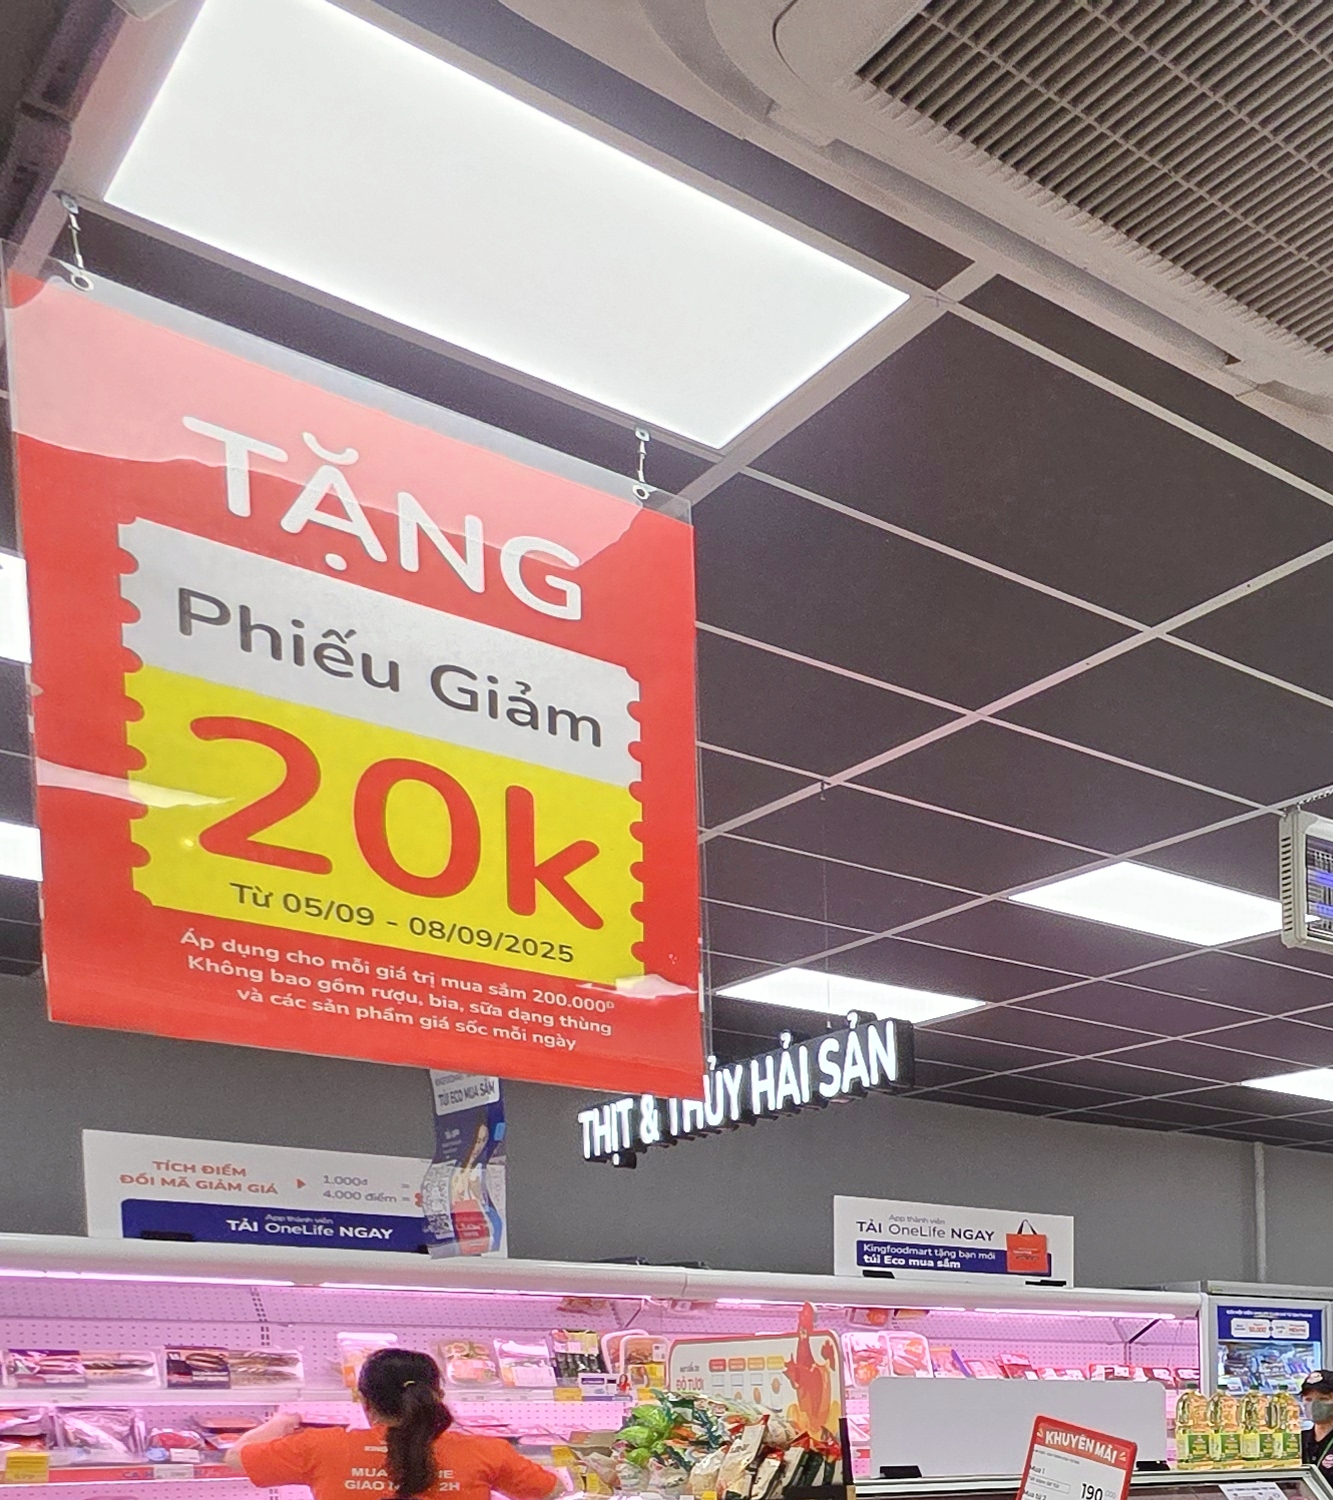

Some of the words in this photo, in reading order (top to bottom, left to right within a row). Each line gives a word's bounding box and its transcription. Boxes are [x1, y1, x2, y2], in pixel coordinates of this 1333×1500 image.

[183, 415, 583, 620] TẶNG
[176, 586, 402, 694] Phiếu
[429, 661, 603, 749] Giảm
[190, 715, 605, 930] 20k
[229, 882, 272, 908] Từ
[283, 892, 375, 927] 05/09
[408, 915, 575, 964] 08/09/2025
[180, 928, 215, 951] Áp
[221, 937, 280, 964] dụng
[285, 948, 325, 968] cho
[330, 955, 370, 976] mỗi
[376, 961, 407, 986] giá
[412, 969, 436, 990] trị
[441, 977, 483, 994] mua
[488, 981, 527, 1001] sắm
[187, 954, 264, 983] Không
[270, 968, 310, 989] bao
[317, 974, 366, 1000] gồm
[370, 986, 424, 1008] rượu,
[429, 993, 464, 1014] bia,
[469, 999, 503, 1018] sữa
[507, 1002, 555, 1029] dạng
[558, 1011, 612, 1037] thùng
[237, 986, 264, 1003] và
[269, 990, 307, 1010] các
[312, 995, 350, 1016] sản
[355, 1003, 414, 1028] phẩm
[419, 1011, 450, 1032] giá
[454, 1018, 489, 1036] sốc
[492, 1023, 527, 1042] mỗi
[532, 1031, 577, 1052] ngày
[577, 1098, 635, 1167] THỊT
[640, 1094, 661, 1145] &
[750, 1031, 810, 1115] HẢI
[818, 1011, 897, 1098] SẢN
[152, 1160, 196, 1173] TÍCH
[200, 1162, 247, 1177] ĐIỂM
[160, 1175, 191, 1189] MÃ
[195, 1177, 242, 1192] GIẢM
[247, 1181, 278, 1195] GIÁ
[226, 1217, 259, 1232] TẢI
[265, 1221, 334, 1237] OneLife
[339, 1226, 393, 1240] NGAY
[856, 1218, 882, 1234] TẢI
[888, 1223, 946, 1239] OneLife
[950, 1228, 995, 1242] NGAY
[863, 1243, 933, 1257] Kingfoodmart
[934, 1248, 957, 1260] tặng
[958, 1249, 977, 1261] bạn
[863, 1254, 881, 1264] túi
[884, 1256, 906, 1266] Eco
[908, 1258, 935, 1267] mua
[937, 1257, 961, 1269] sắm
